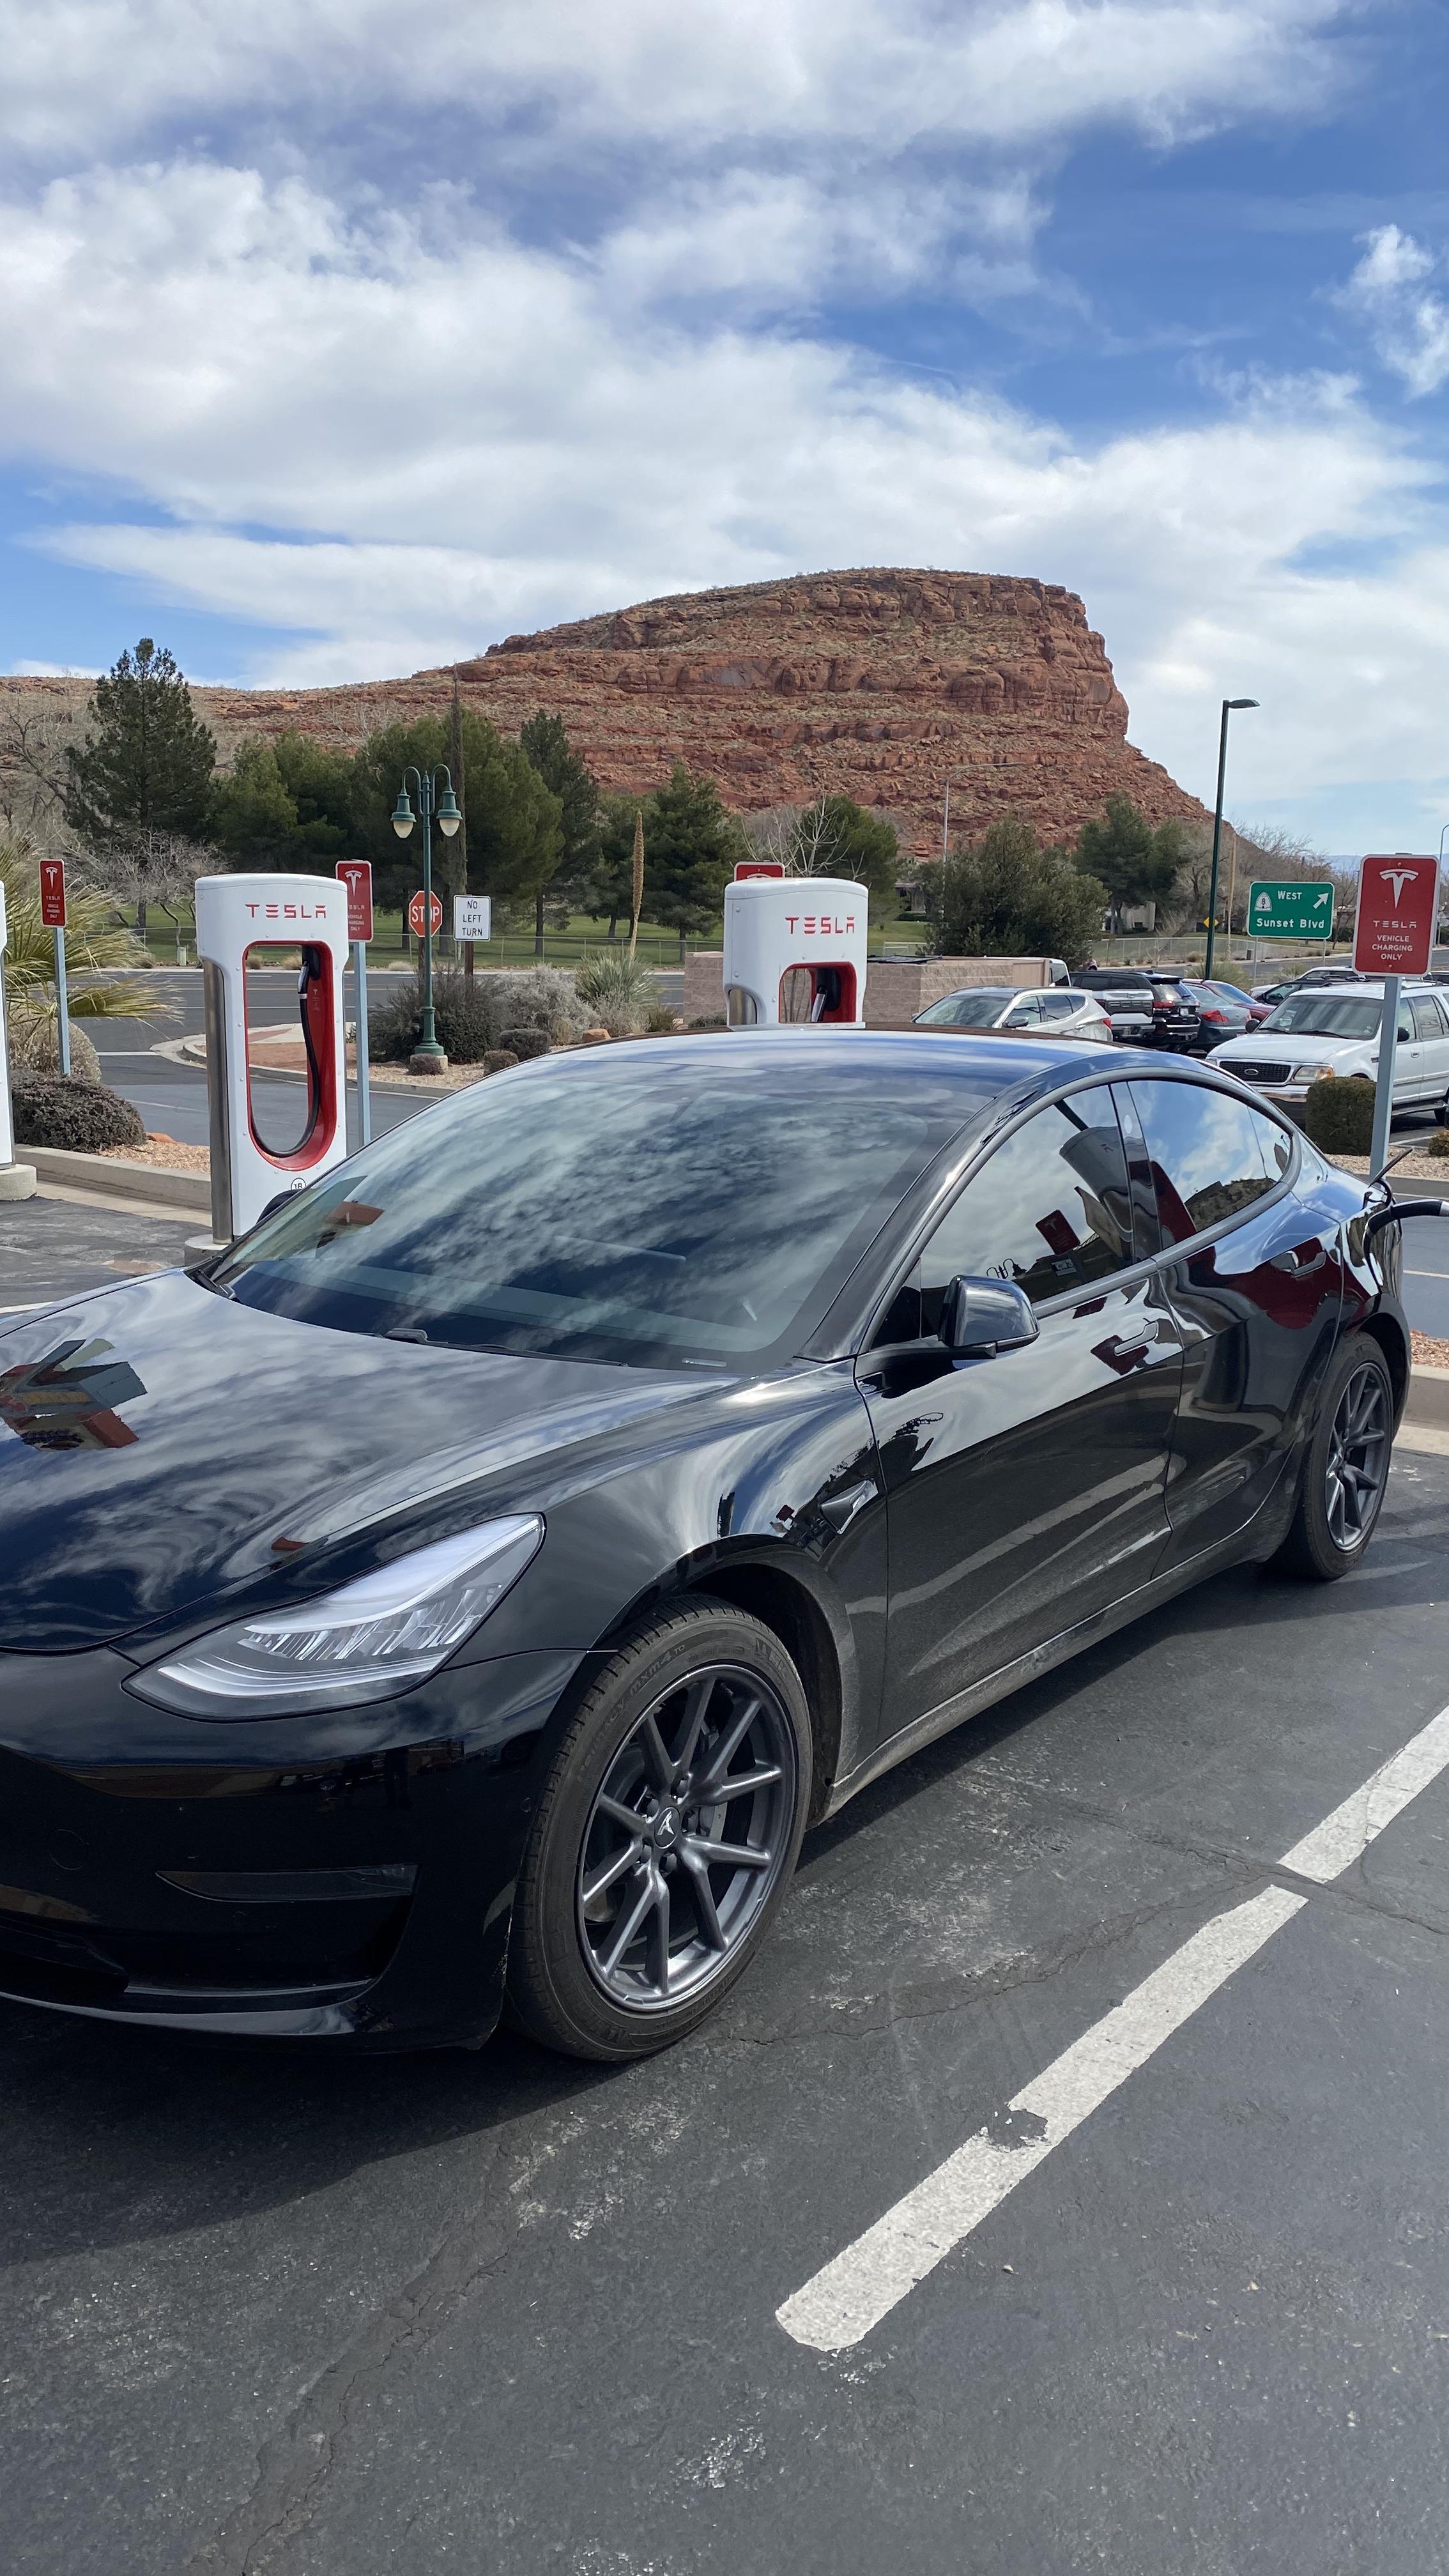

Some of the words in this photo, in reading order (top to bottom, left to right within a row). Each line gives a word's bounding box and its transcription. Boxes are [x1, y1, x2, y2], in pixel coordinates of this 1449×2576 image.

[1278, 891, 1303, 900] WEST
[467, 900, 478, 910] NO
[245, 904, 326, 918] TESLA
[463, 914, 482, 923] LEFT
[1256, 918, 1294, 928] Sunset
[1300, 919, 1324, 928] Blvd
[785, 917, 855, 935] TESLA
[1372, 920, 1417, 928] TESLA
[462, 928, 483, 936] TURN
